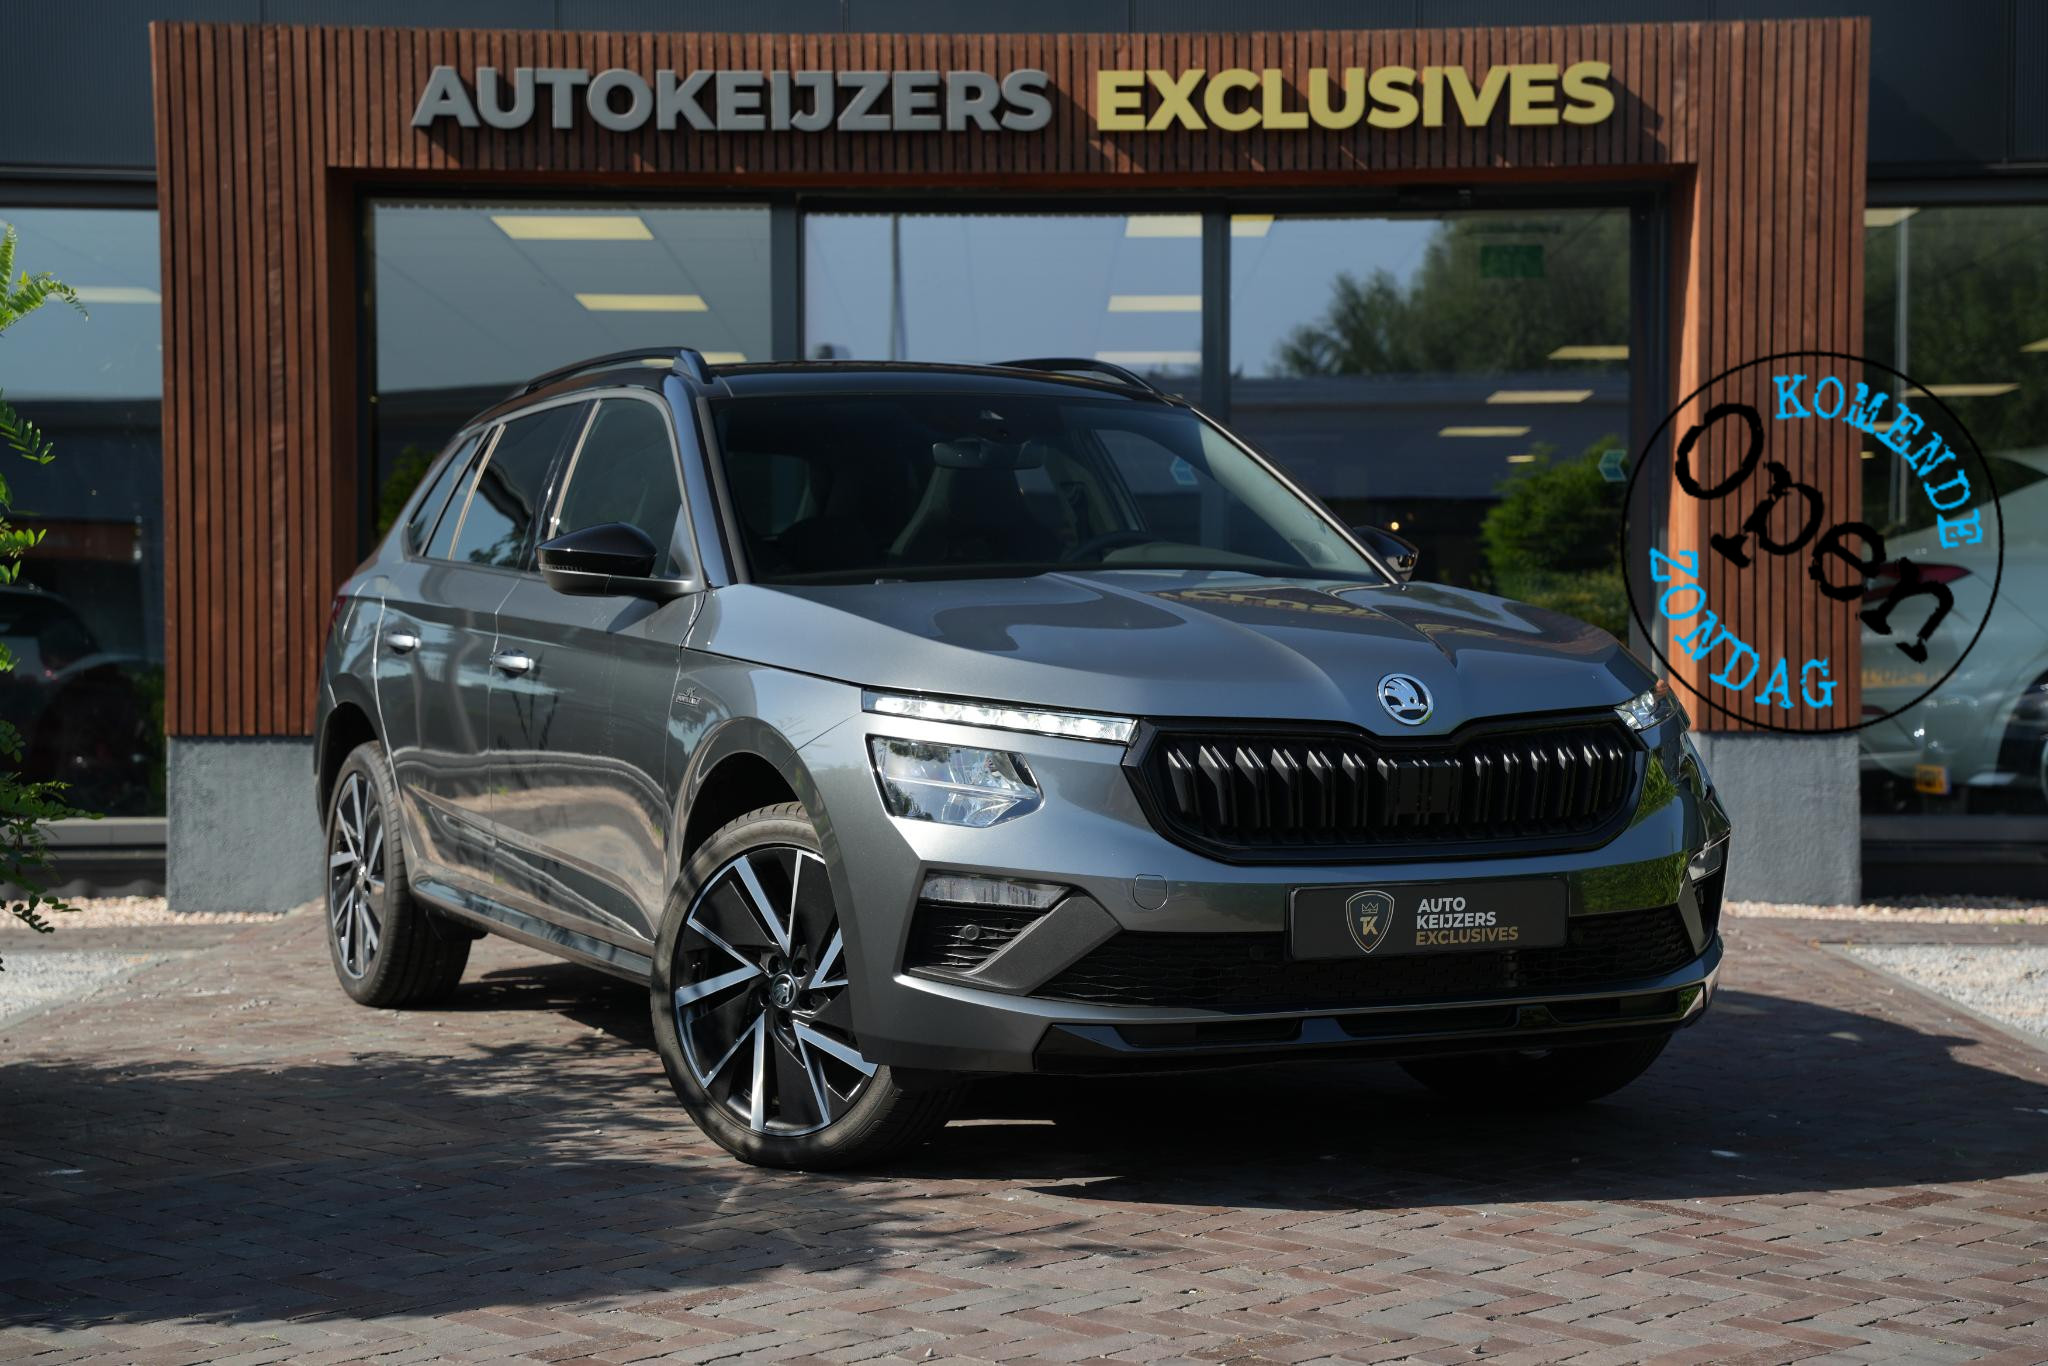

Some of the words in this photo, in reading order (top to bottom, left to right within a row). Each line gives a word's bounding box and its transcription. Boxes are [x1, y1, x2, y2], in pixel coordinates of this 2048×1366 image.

[411, 65, 1053, 133] AUTOKEIJZERS
[1097, 61, 1616, 131] EXCLUSIVES
[1417, 896, 1466, 914] AUTO
[1416, 911, 1497, 930] KEIJZERS
[1415, 926, 1519, 946] EXCLUSIVES
